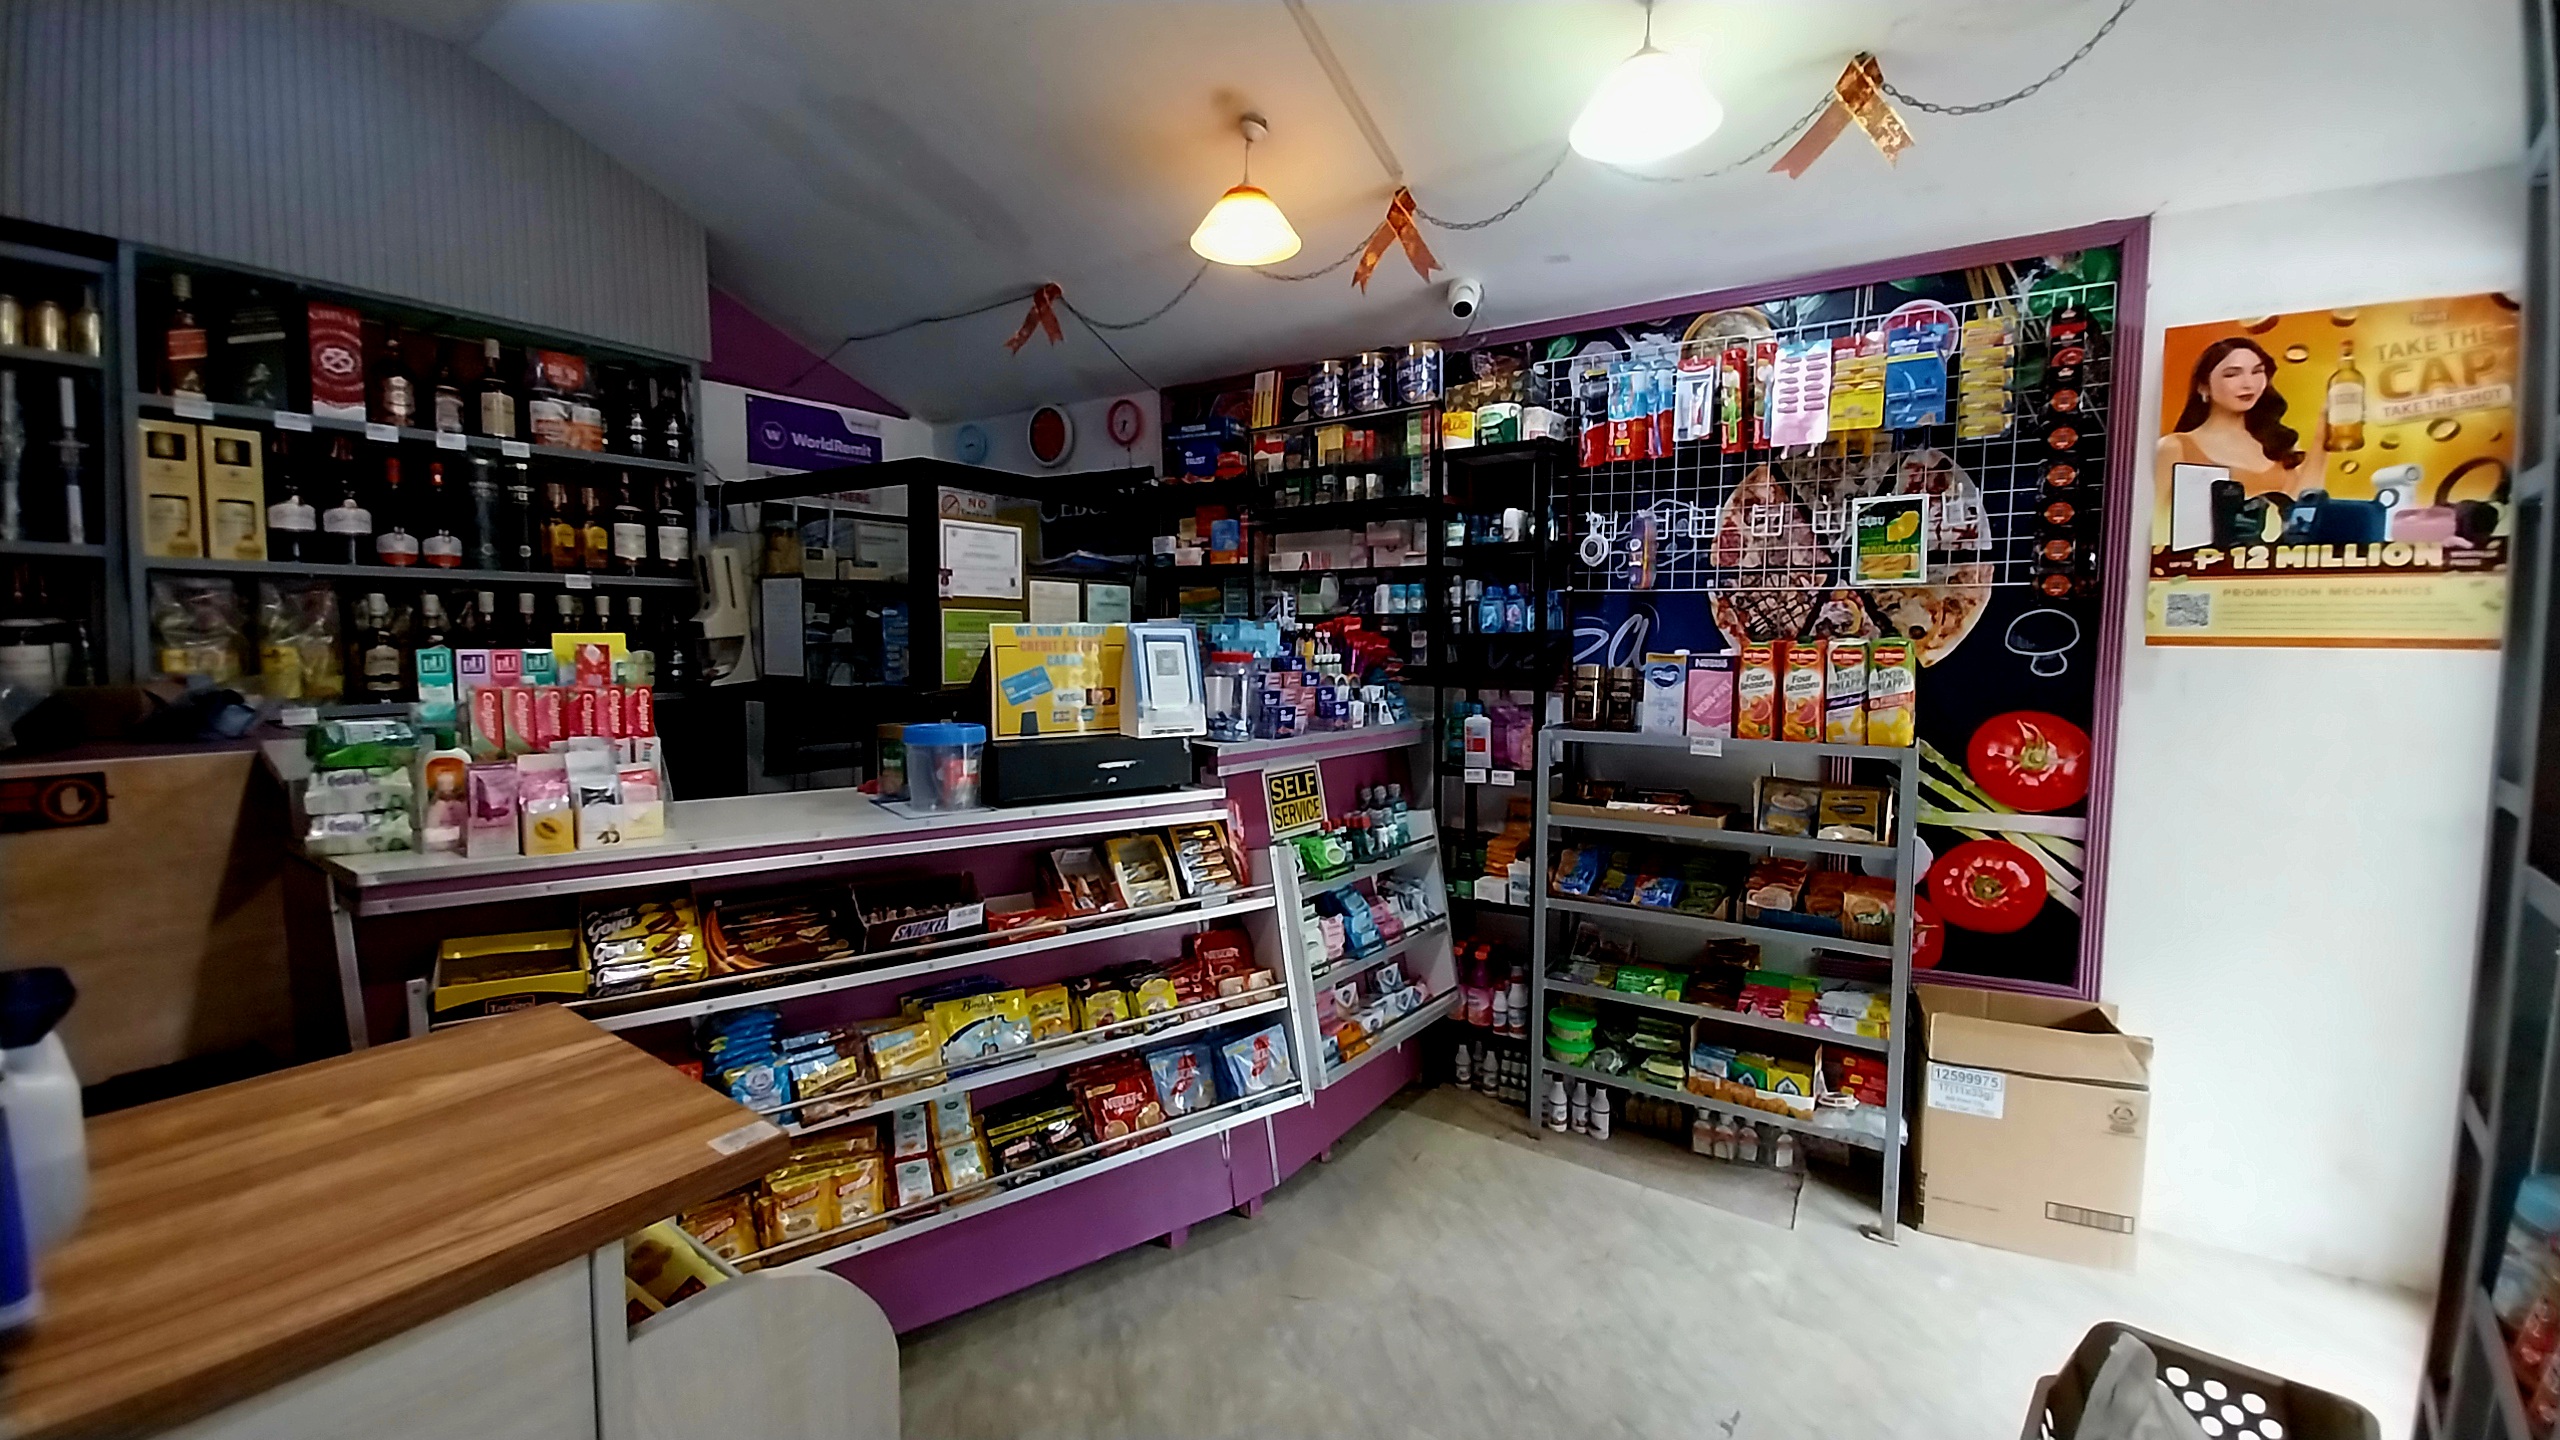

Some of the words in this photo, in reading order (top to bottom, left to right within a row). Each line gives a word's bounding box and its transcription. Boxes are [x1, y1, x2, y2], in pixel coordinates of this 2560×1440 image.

[2375, 335, 2437, 361] TAKE
[2444, 326, 2496, 348] THE
[2378, 349, 2497, 399] CAP
[2384, 402, 2421, 417] TAKE
[2428, 397, 2456, 412] THE
[2461, 389, 2502, 406] SHOT
[791, 431, 872, 458] WorldRemit
[968, 497, 987, 509] NO
[2230, 546, 2270, 570] 12
[2275, 541, 2445, 569] MILLION
[2222, 586, 2323, 598] PROMOTION
[2328, 585, 2434, 597] MECHANICS
[1740, 679, 1773, 690] Seasons
[1745, 673, 1766, 682] Four
[1785, 681, 1820, 692] Seasons
[1791, 674, 1812, 683] Four
[482, 691, 496, 740] Colgate
[515, 691, 529, 739] Colgate
[548, 690, 562, 737] Colgate
[608, 688, 622, 734] Colgate
[637, 687, 651, 733] Colgate
[1270, 772, 1315, 802] SELF
[1273, 798, 1320, 829] SERVICE
[588, 915, 636, 942] Goya
[892, 916, 948, 942] SNICKER
[1935, 1067, 1999, 1088] 12599975
